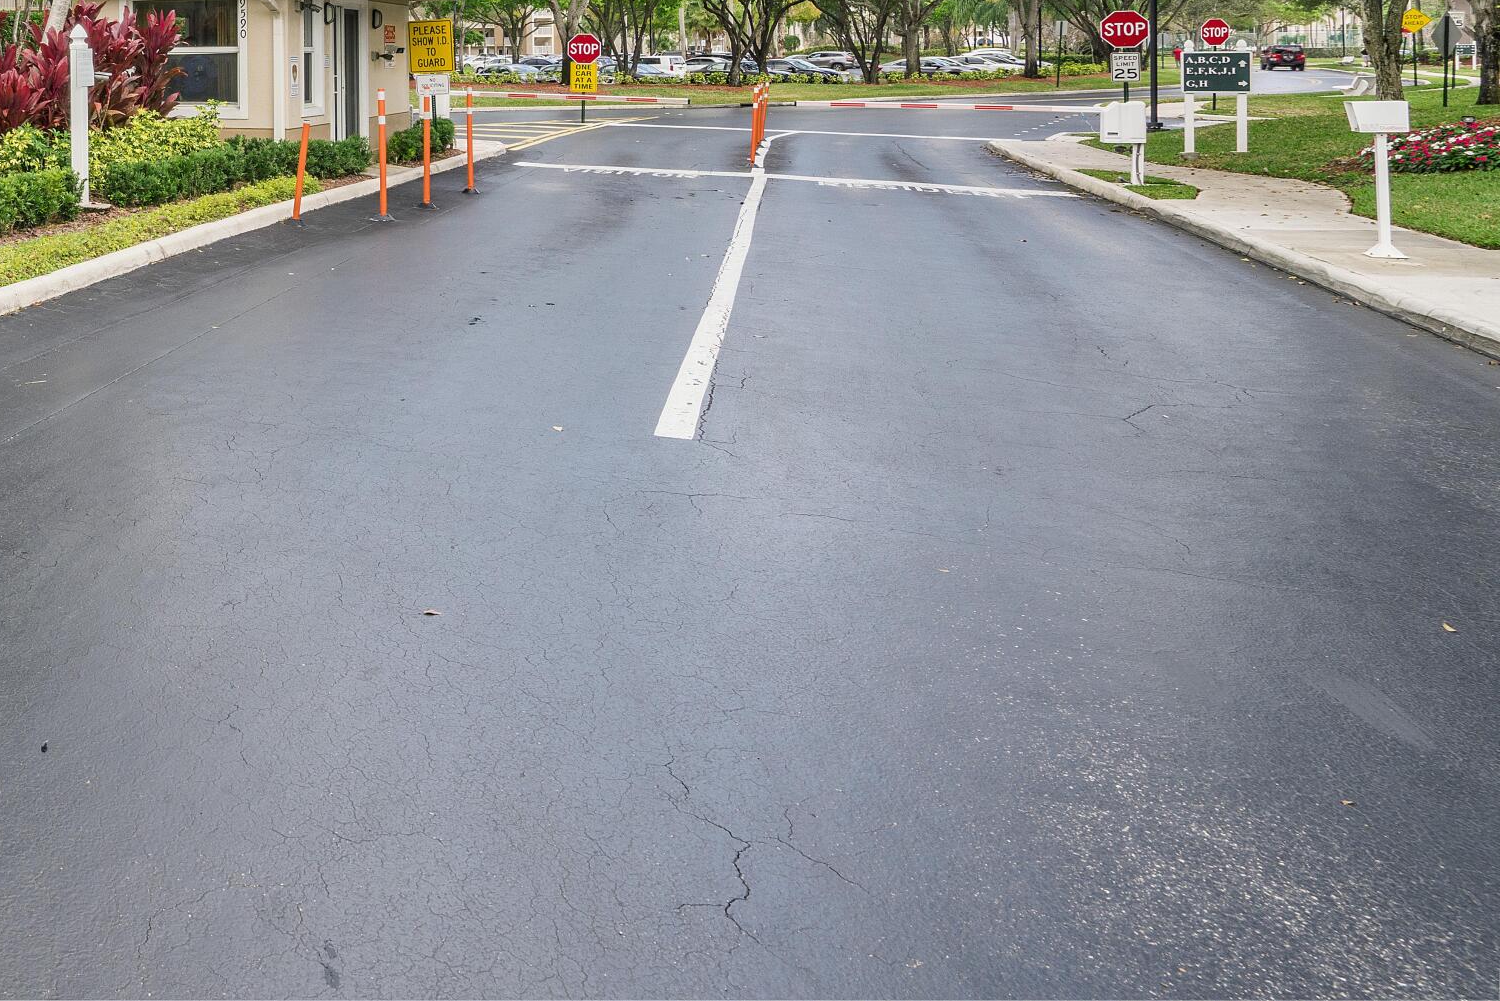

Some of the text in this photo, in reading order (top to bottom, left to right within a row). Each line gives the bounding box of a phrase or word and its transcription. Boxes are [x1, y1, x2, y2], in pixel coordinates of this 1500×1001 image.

[413, 25, 447, 36] PLEASE
[1103, 22, 1146, 37] STOP
[1202, 26, 1228, 38] STOP
[412, 36, 450, 47] SHOW I.D.
[425, 47, 437, 57] TO
[569, 43, 599, 55] STOP
[417, 58, 446, 68] GUARD
[1185, 56, 1231, 65] A,B,C,D
[1114, 68, 1138, 79] 25
[1185, 80, 1209, 88] G,H
